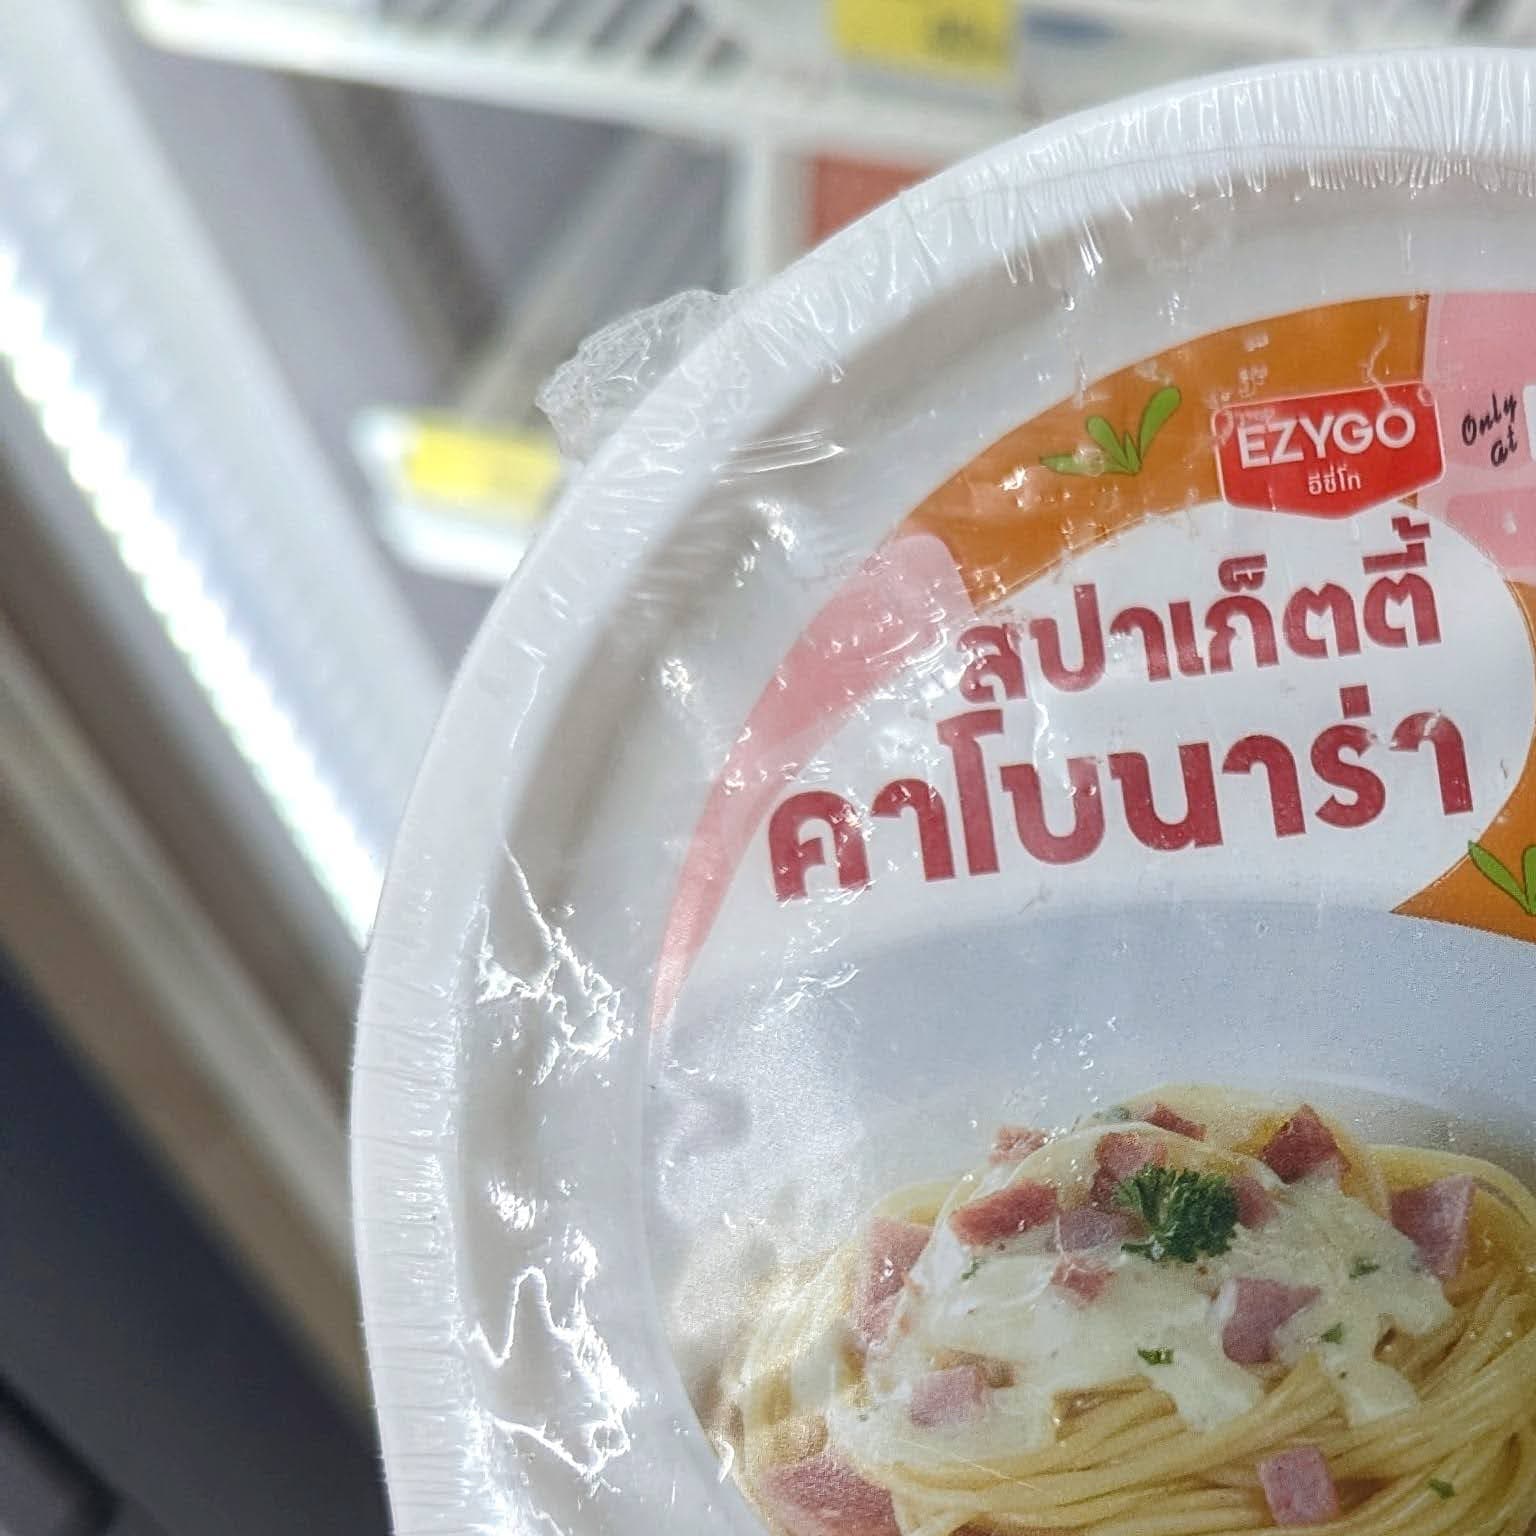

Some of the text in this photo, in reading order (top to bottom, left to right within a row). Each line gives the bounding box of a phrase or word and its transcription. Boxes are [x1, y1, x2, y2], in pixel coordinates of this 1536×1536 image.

[1237, 407, 1416, 469] EZYGO
[1462, 394, 1516, 446] Only
[1491, 438, 1518, 467] at
[959, 517, 1442, 704] สปาเก็ตตี้
[770, 685, 1474, 901] คาโบนาร่า
